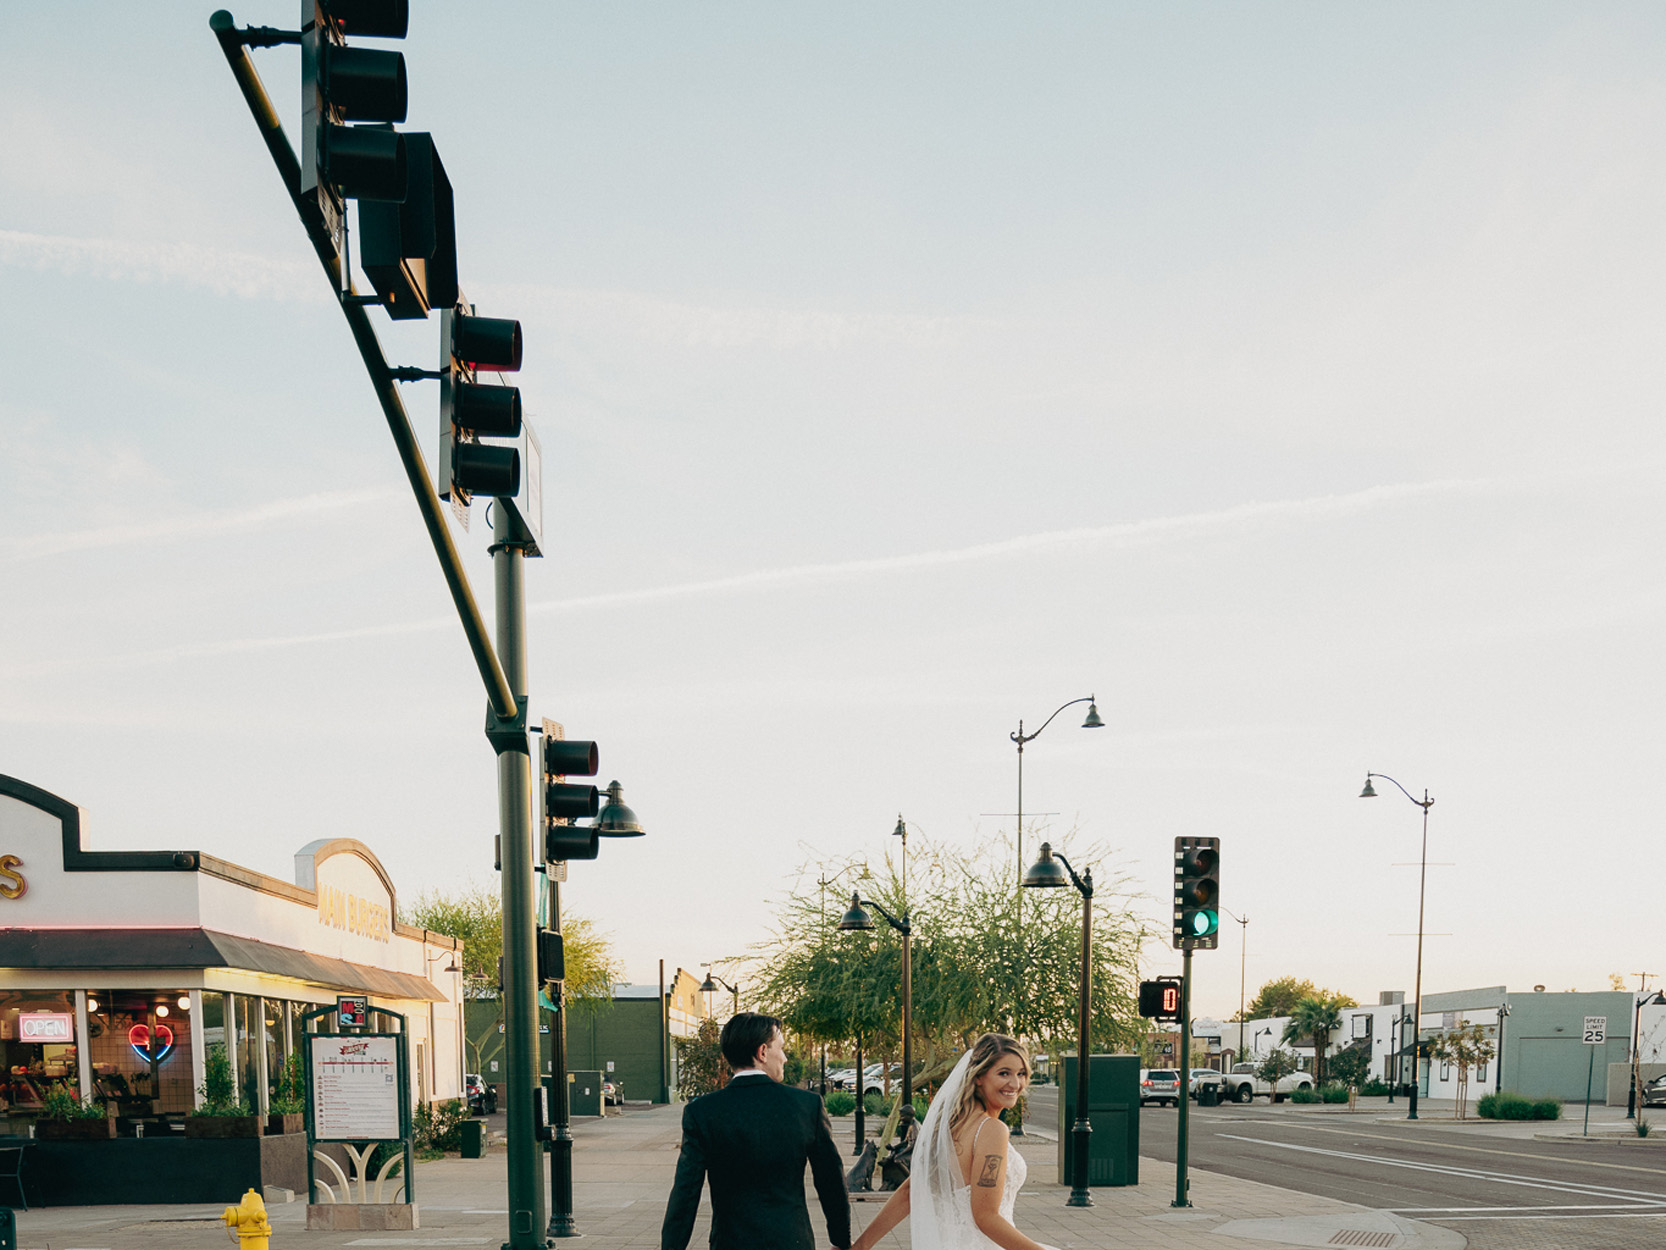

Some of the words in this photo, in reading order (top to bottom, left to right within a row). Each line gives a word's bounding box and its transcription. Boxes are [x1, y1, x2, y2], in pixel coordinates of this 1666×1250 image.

[318, 881, 346, 931] MAIN
[347, 893, 389, 944] BURGERS
[1163, 988, 1176, 1011] 10
[23, 1020, 66, 1036] OPEN
[1584, 1030, 1603, 1042] 25
